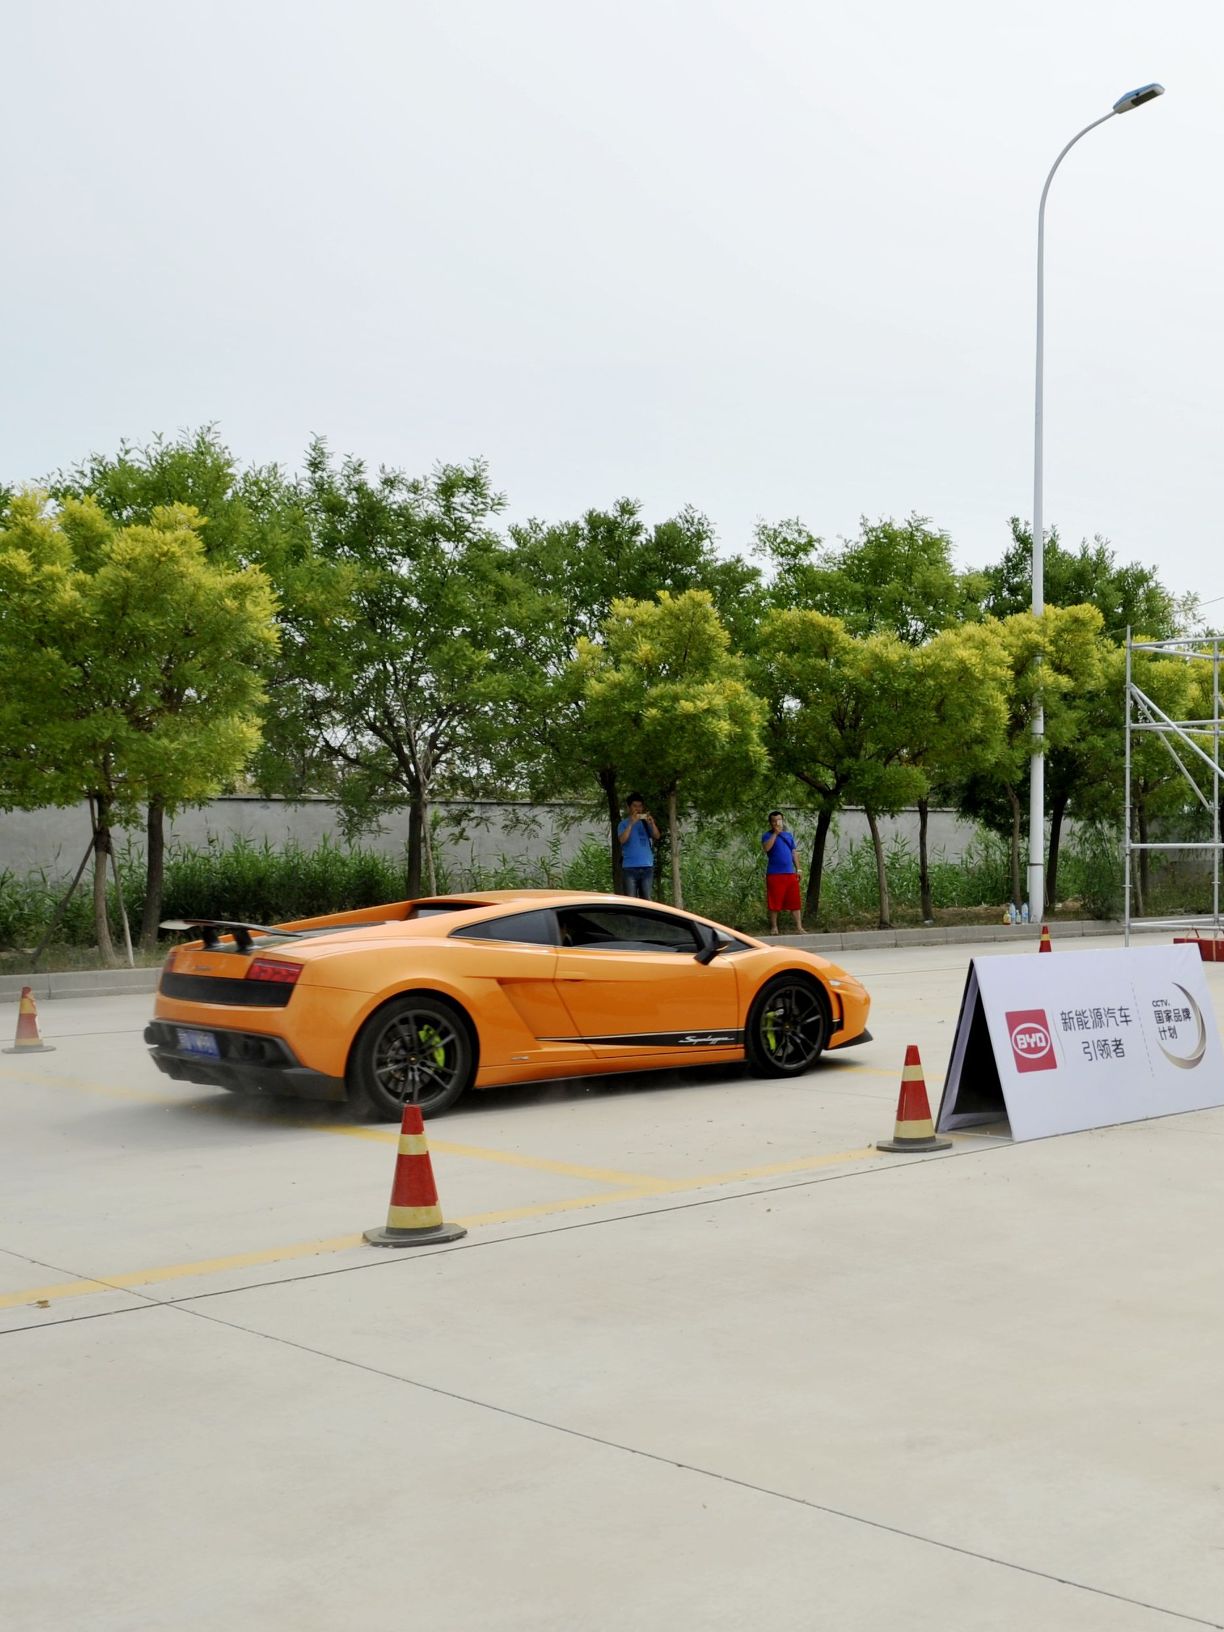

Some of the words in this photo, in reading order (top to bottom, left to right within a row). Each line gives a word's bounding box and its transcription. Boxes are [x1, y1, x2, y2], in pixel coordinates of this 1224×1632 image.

[1060, 1006, 1133, 1032] 新能源汽车
[1154, 1008, 1192, 1026] 国家品牌
[1016, 1034, 1046, 1050] BYD
[1158, 1026, 1178, 1041] 计划
[1081, 1038, 1125, 1062] 引领者
